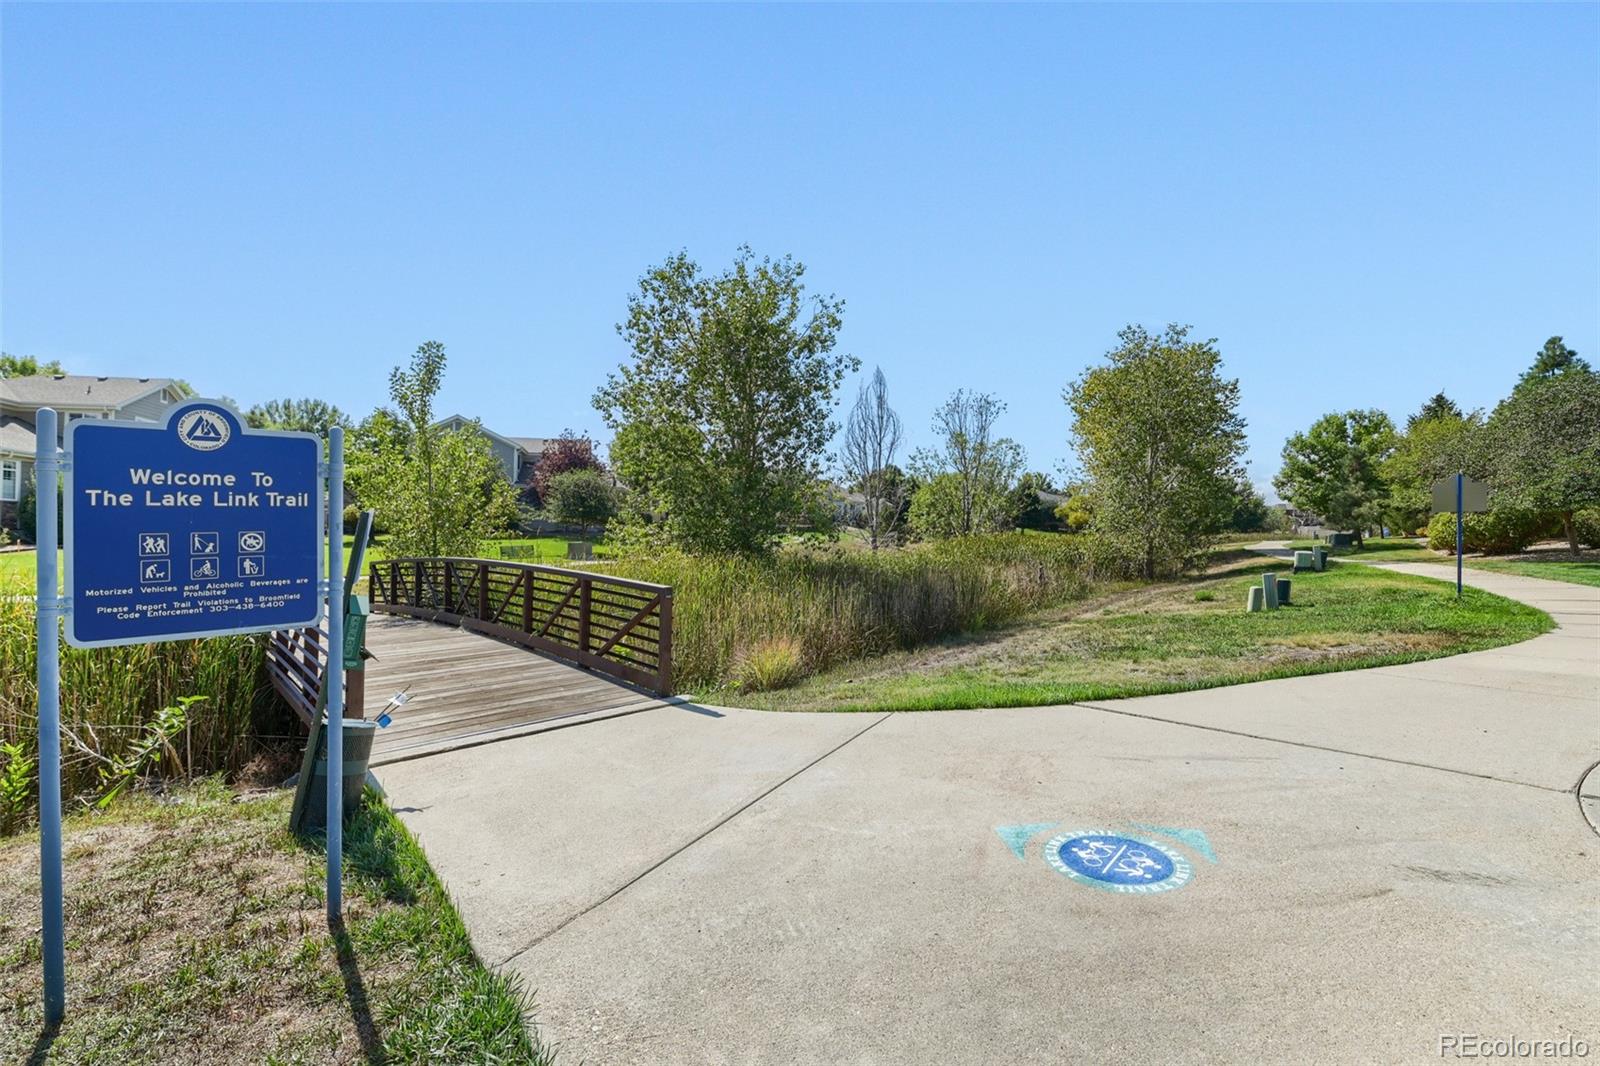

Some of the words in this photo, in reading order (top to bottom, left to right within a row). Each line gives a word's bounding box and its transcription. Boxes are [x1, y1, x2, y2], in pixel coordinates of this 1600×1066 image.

[129, 468, 236, 485] Welcome
[251, 471, 273, 487] To
[85, 489, 133, 507] The
[146, 490, 202, 507] Lake
[214, 491, 259, 507] Link
[265, 492, 309, 507] Trail
[85, 587, 134, 597] Motorized
[140, 585, 178, 594] Vehicles
[184, 583, 200, 591] and
[206, 581, 244, 590] Alcoholic
[250, 579, 291, 587] Beverages
[183, 589, 227, 598] Prohibited
[96, 606, 129, 614] Please
[135, 602, 167, 612] Report
[173, 601, 191, 609] Trail
[197, 597, 239, 606] Violations
[259, 593, 301, 602] Broomfield
[117, 611, 140, 620] Code
[147, 607, 203, 617] Enforcement
[209, 600, 285, 613] 303-438-6400
